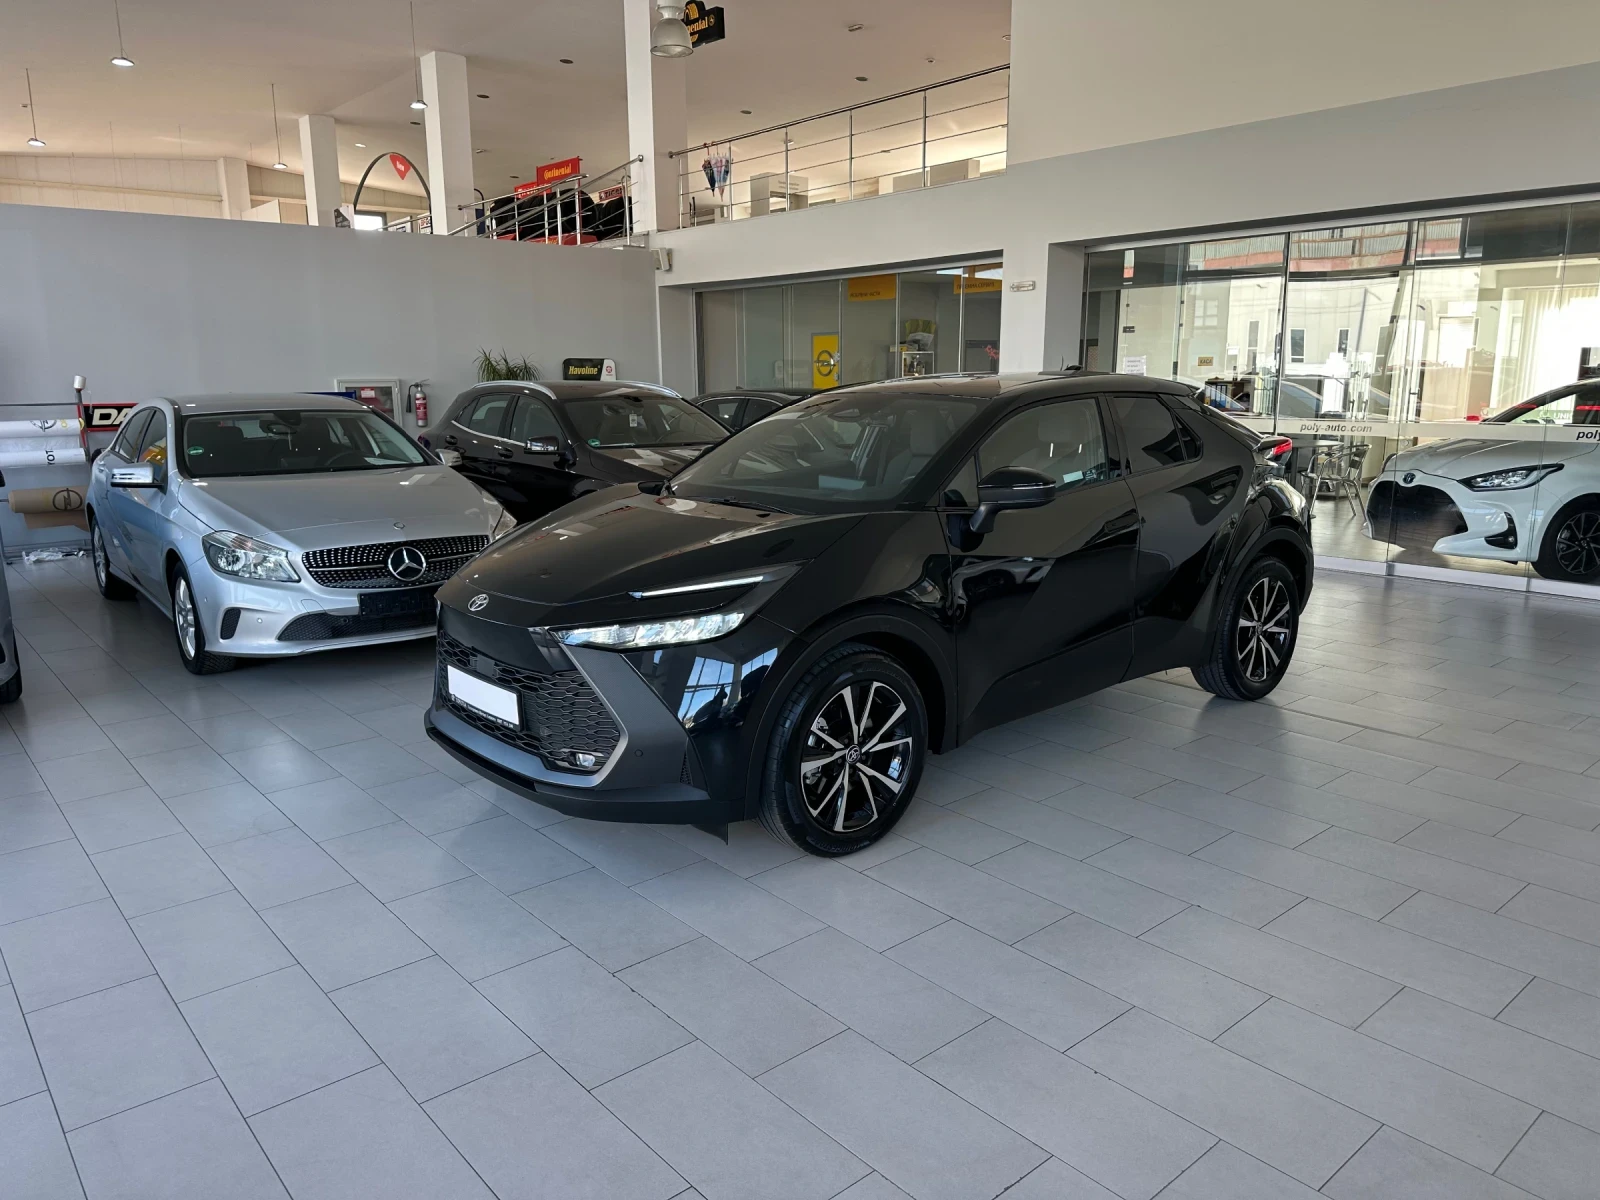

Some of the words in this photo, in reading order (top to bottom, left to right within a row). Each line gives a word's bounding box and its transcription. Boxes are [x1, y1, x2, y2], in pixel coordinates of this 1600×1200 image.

[544, 163, 572, 180] Continental
[568, 365, 598, 375] Havoline
[1300, 423, 1372, 433] poly-auto.com
